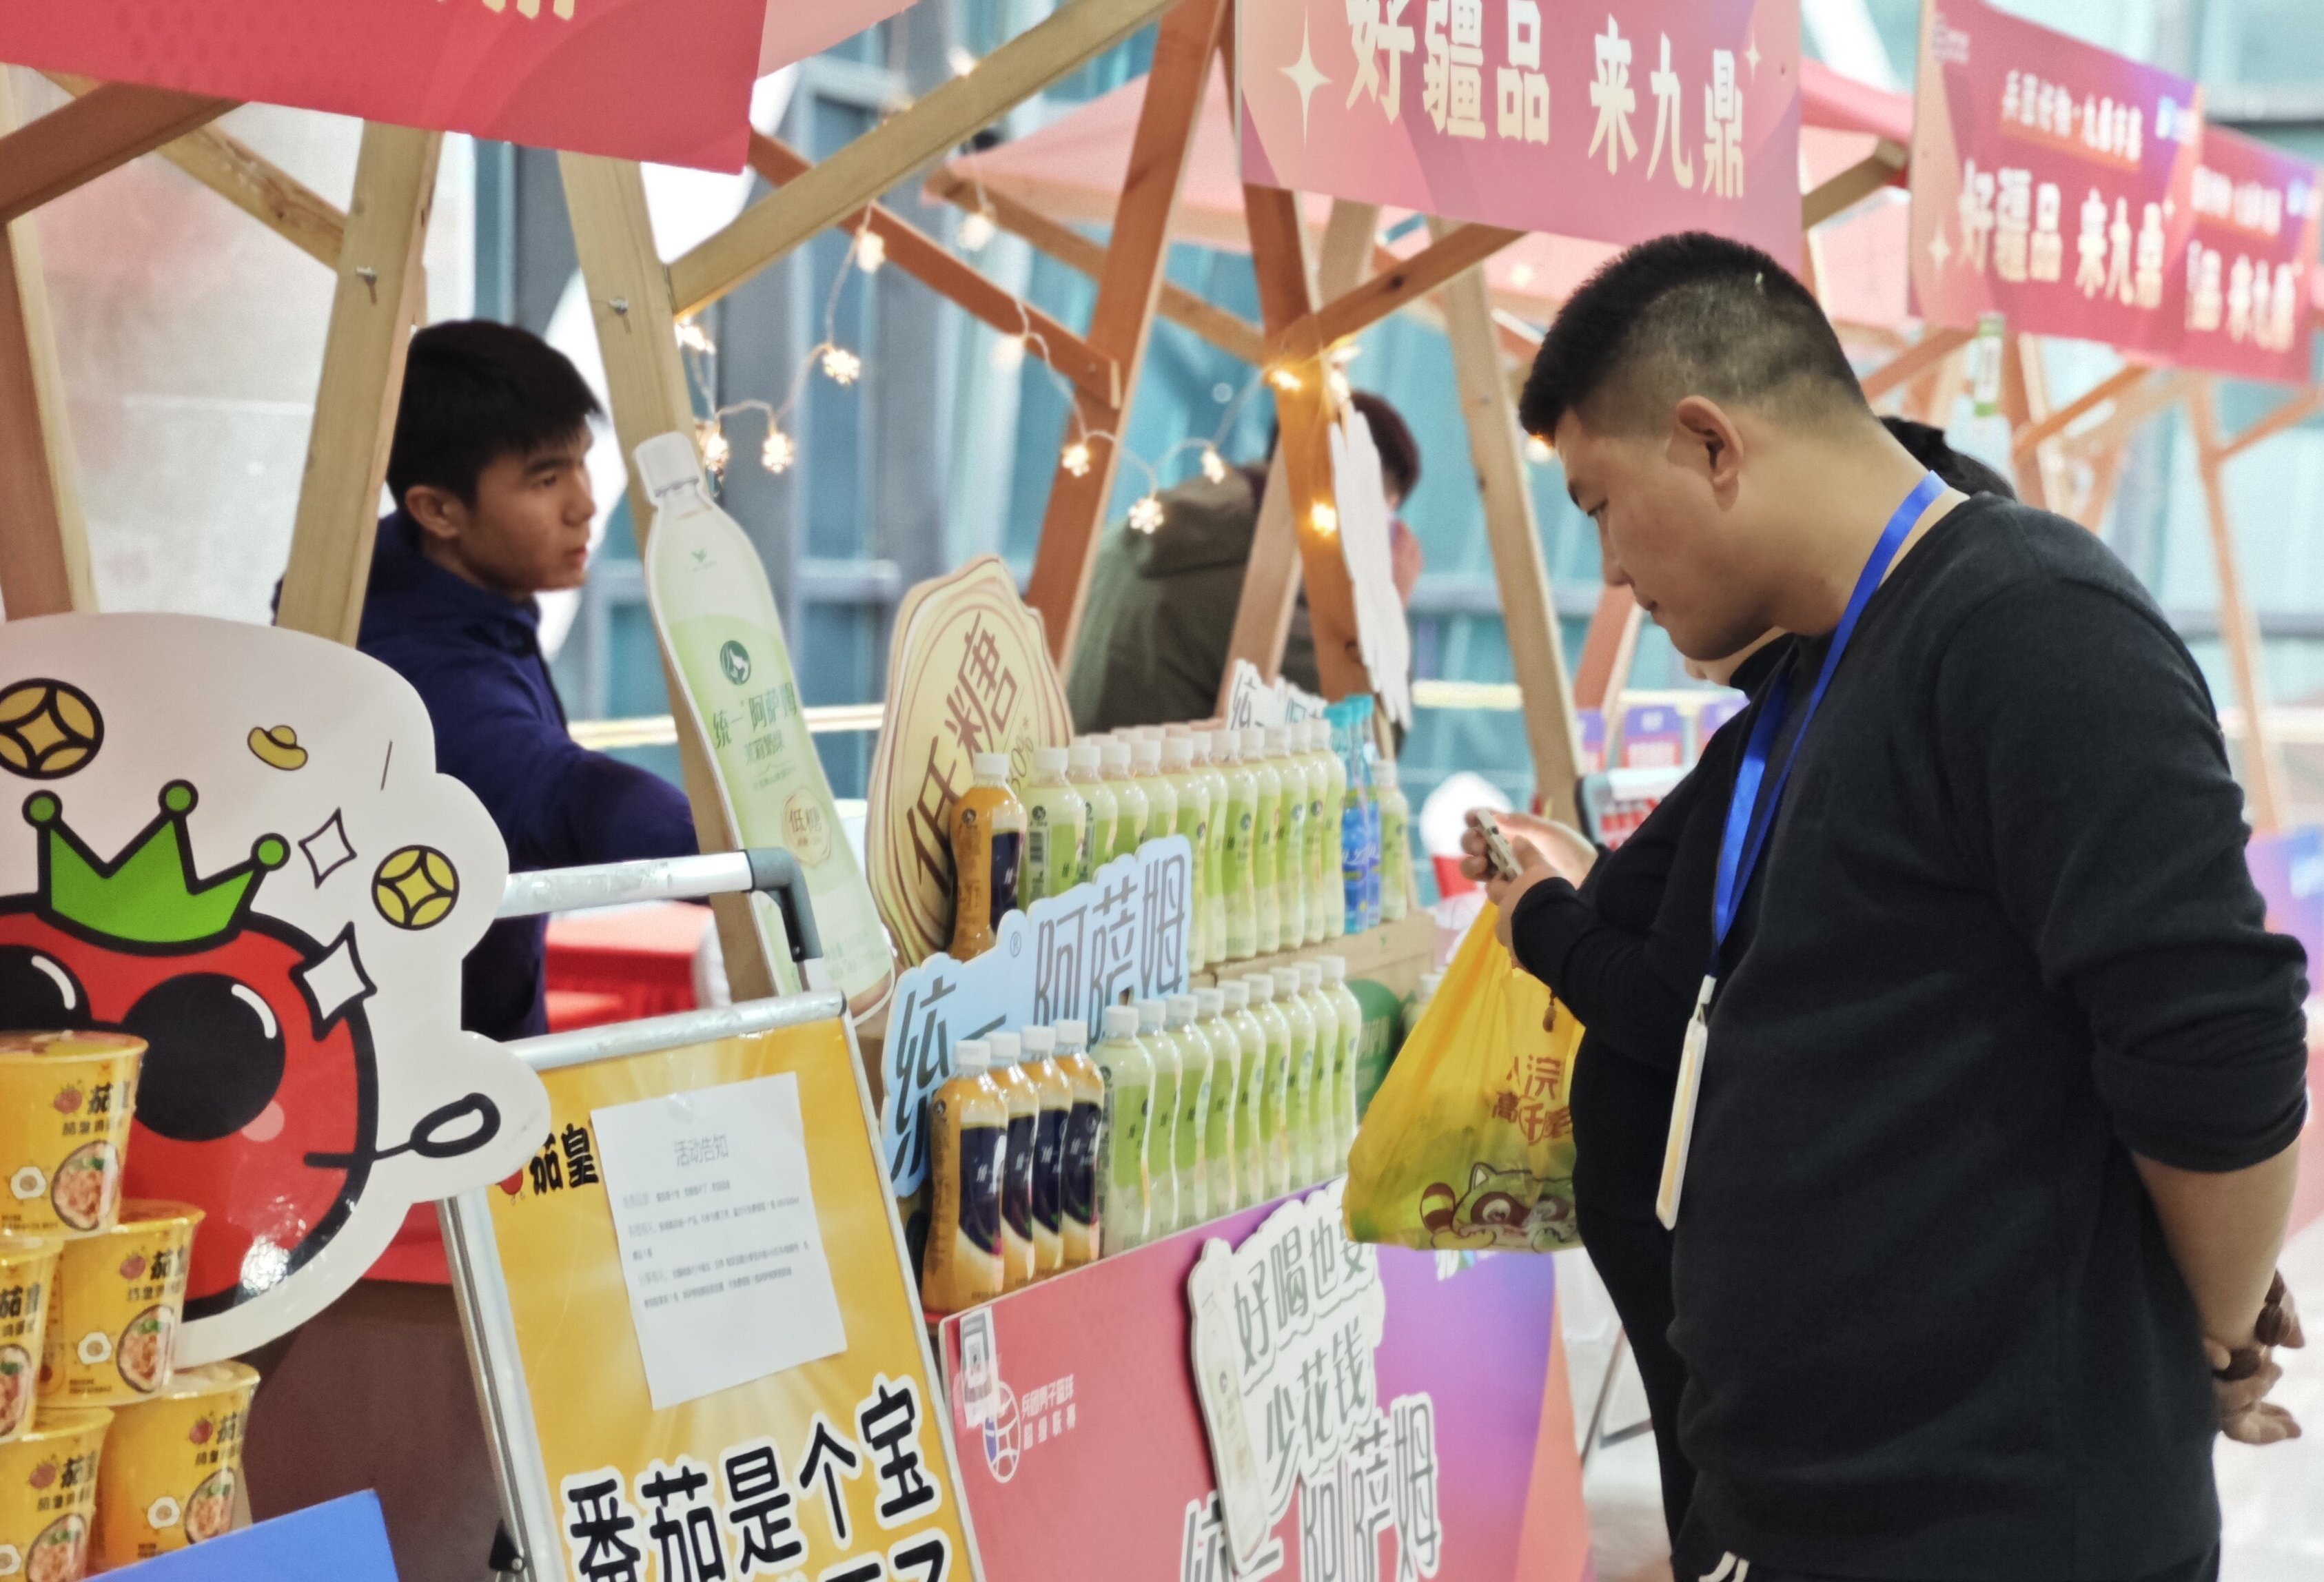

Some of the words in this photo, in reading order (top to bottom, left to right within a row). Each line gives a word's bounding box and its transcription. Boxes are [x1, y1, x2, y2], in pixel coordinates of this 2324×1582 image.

[1345, 0, 1550, 145] 好疆品
[1588, 14, 1745, 199] 来九鼎
[673, 1133, 729, 1167] 活动告知
[567, 1384, 935, 1582] 番茄是个宝
[1266, 1315, 1367, 1497] 少花钱
